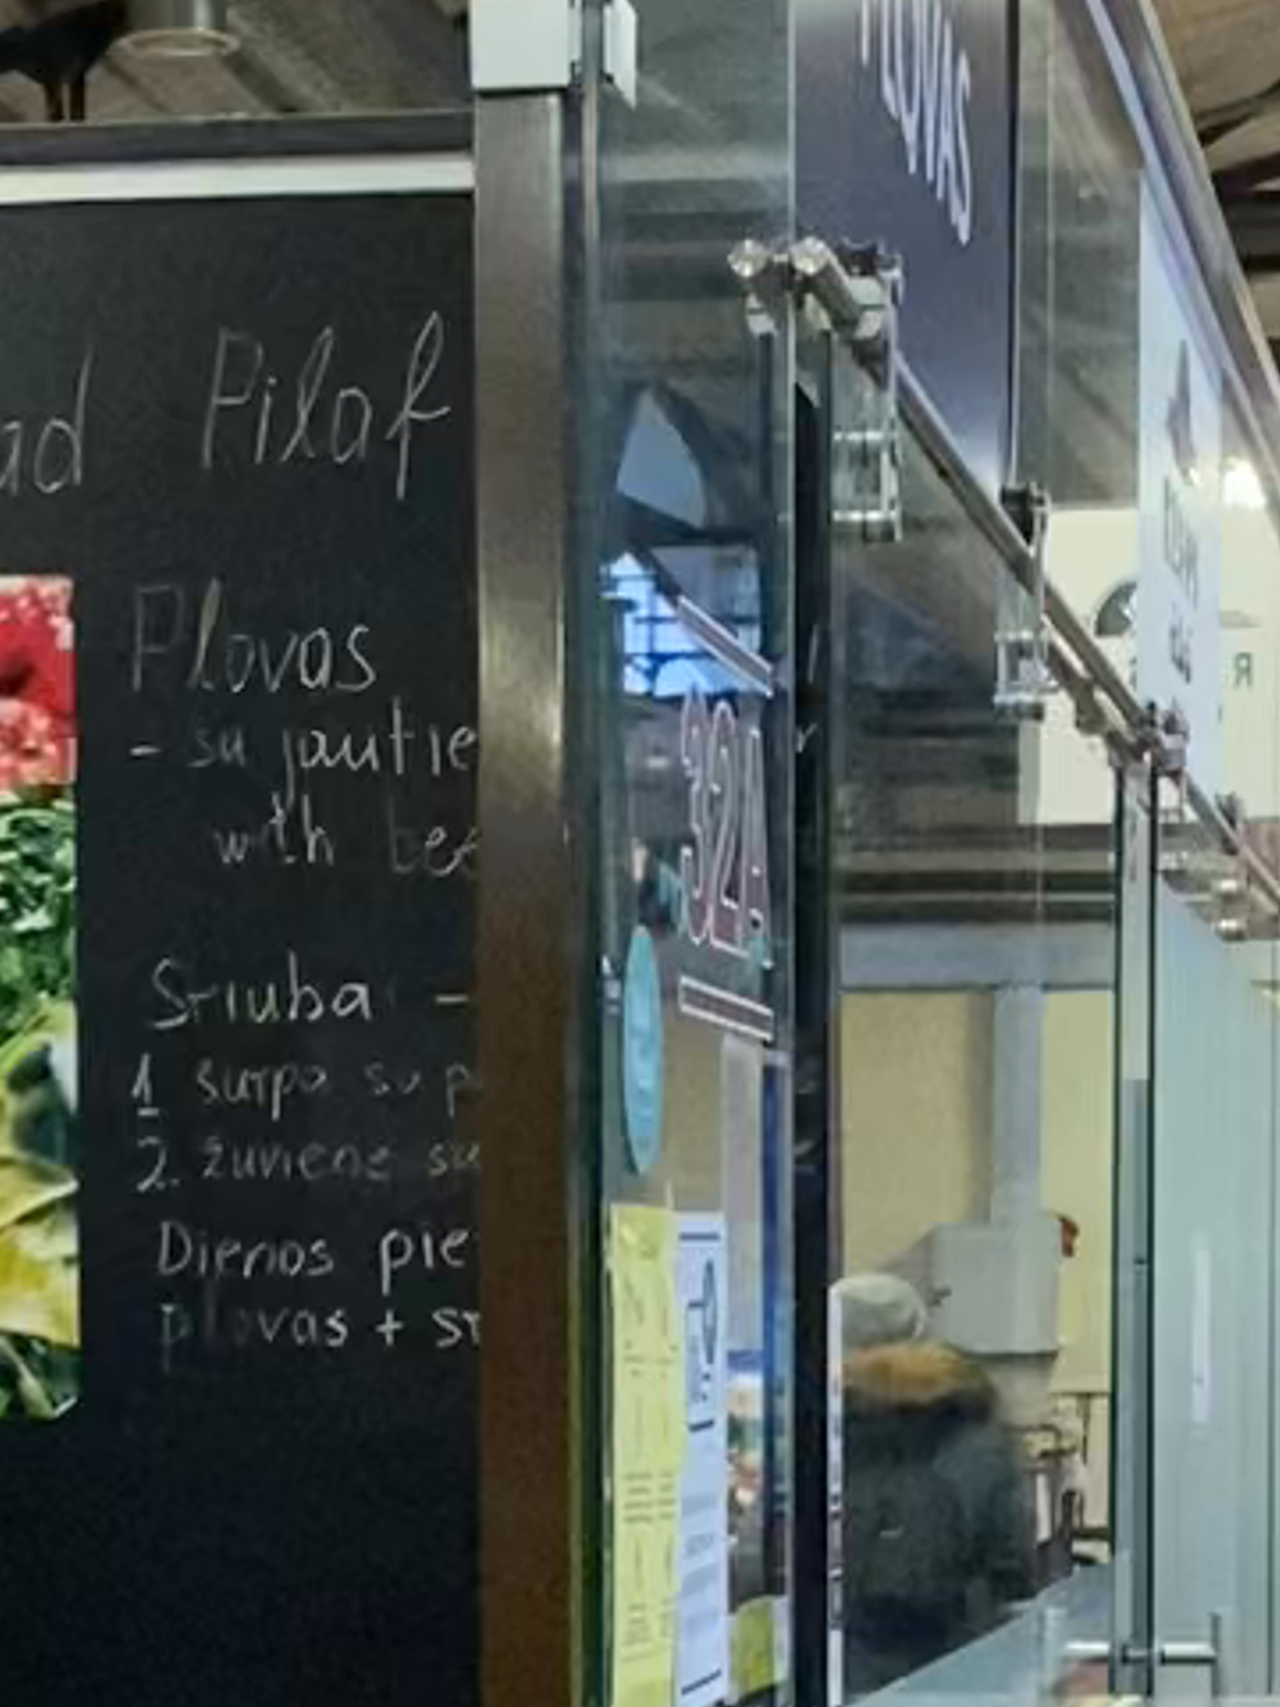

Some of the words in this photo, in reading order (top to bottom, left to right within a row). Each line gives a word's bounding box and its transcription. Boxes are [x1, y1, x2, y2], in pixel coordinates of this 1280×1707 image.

[198, 309, 453, 500] Pilaf
[131, 575, 377, 693] Plovas
[157, 1219, 335, 1280] Dienos
